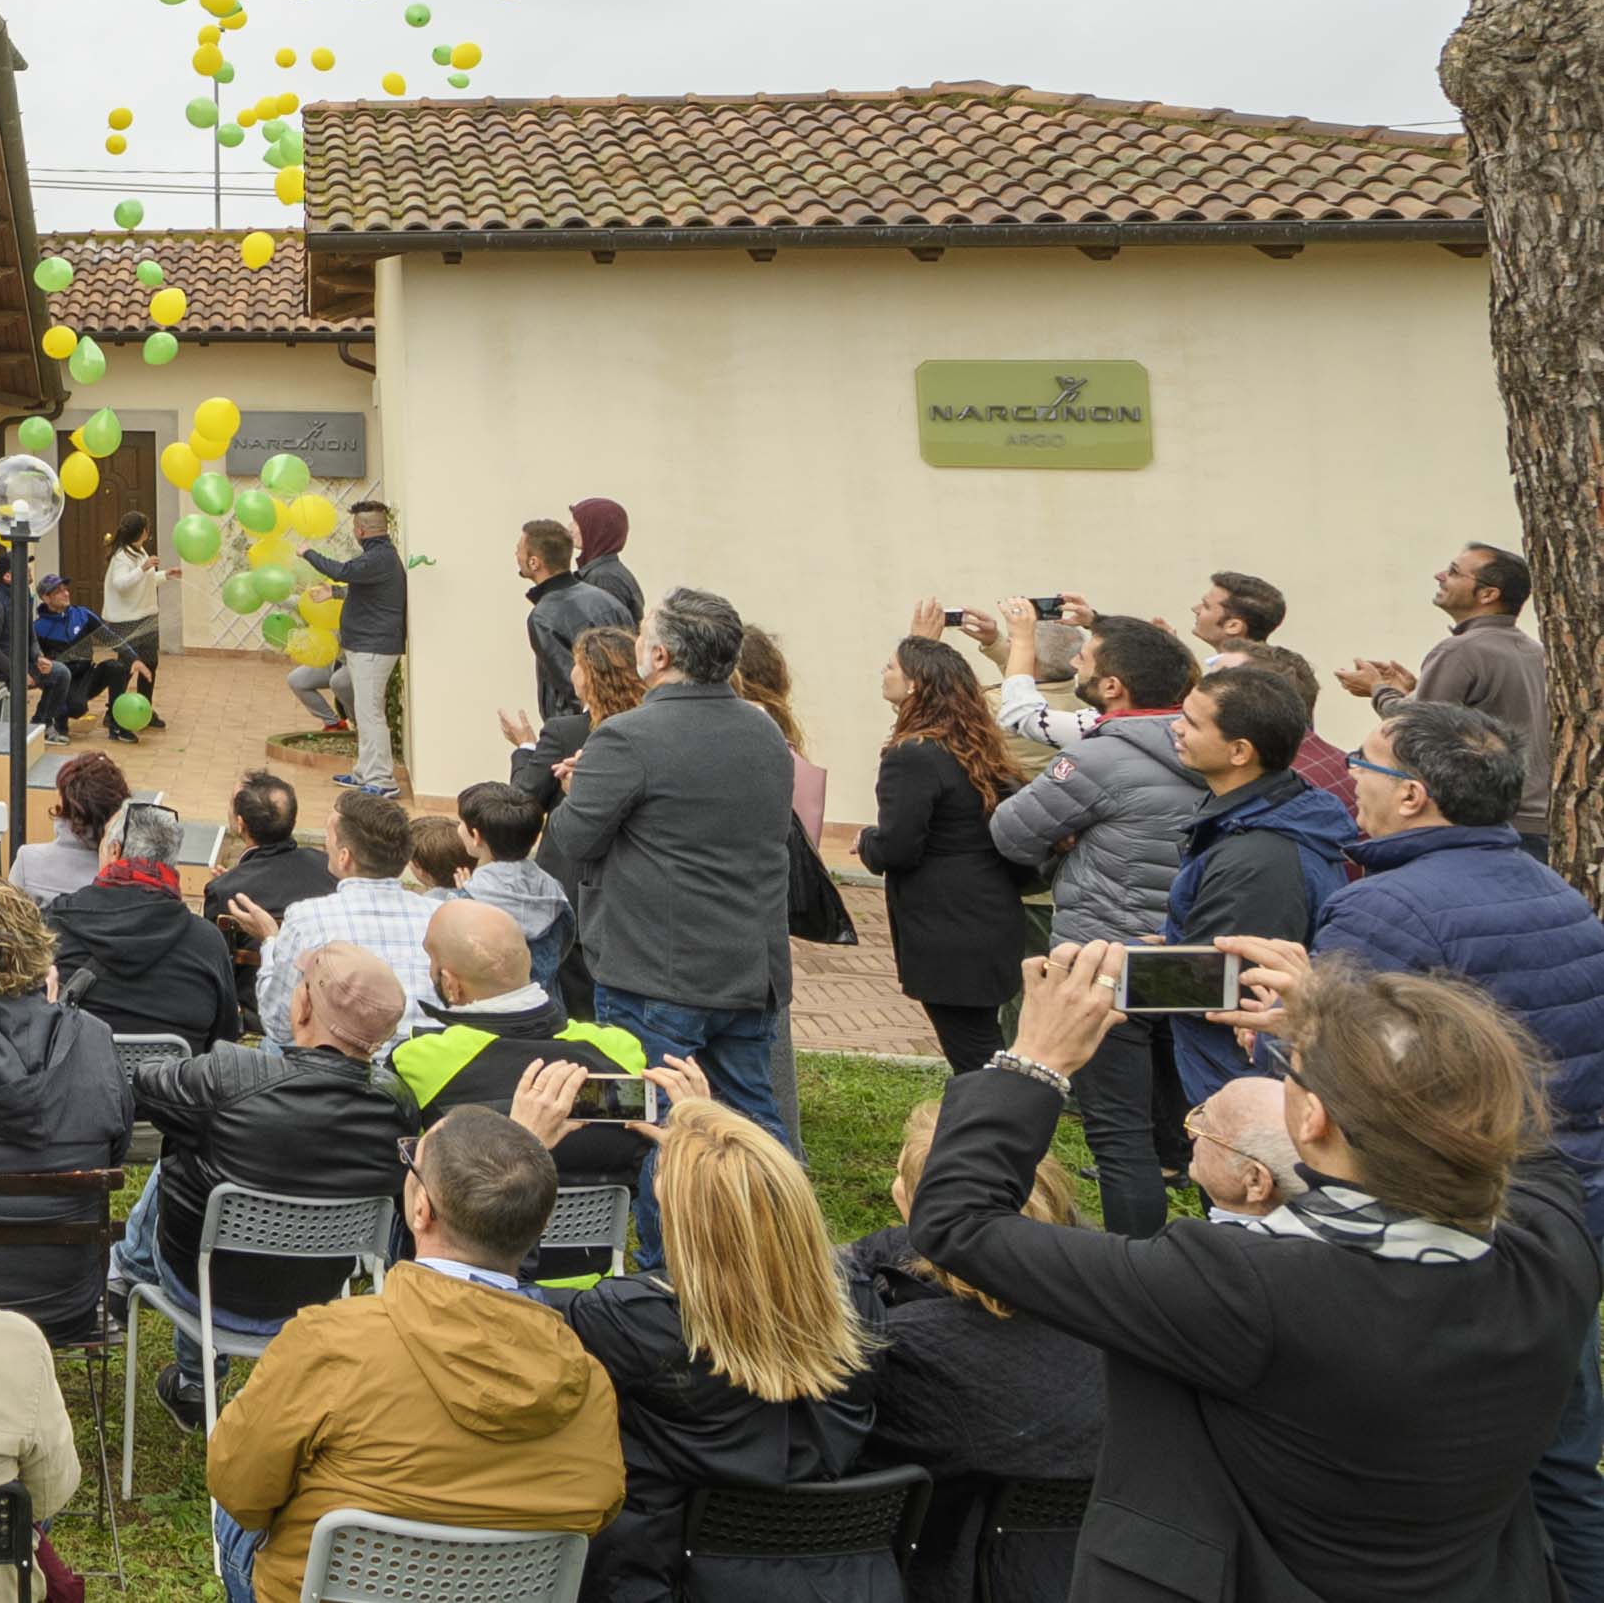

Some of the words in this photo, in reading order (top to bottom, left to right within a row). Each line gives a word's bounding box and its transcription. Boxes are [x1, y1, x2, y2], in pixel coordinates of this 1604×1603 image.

[929, 404, 1143, 423] NARCONON
[233, 438, 359, 452] NARCONON
[1005, 433, 1067, 449] ARGO
